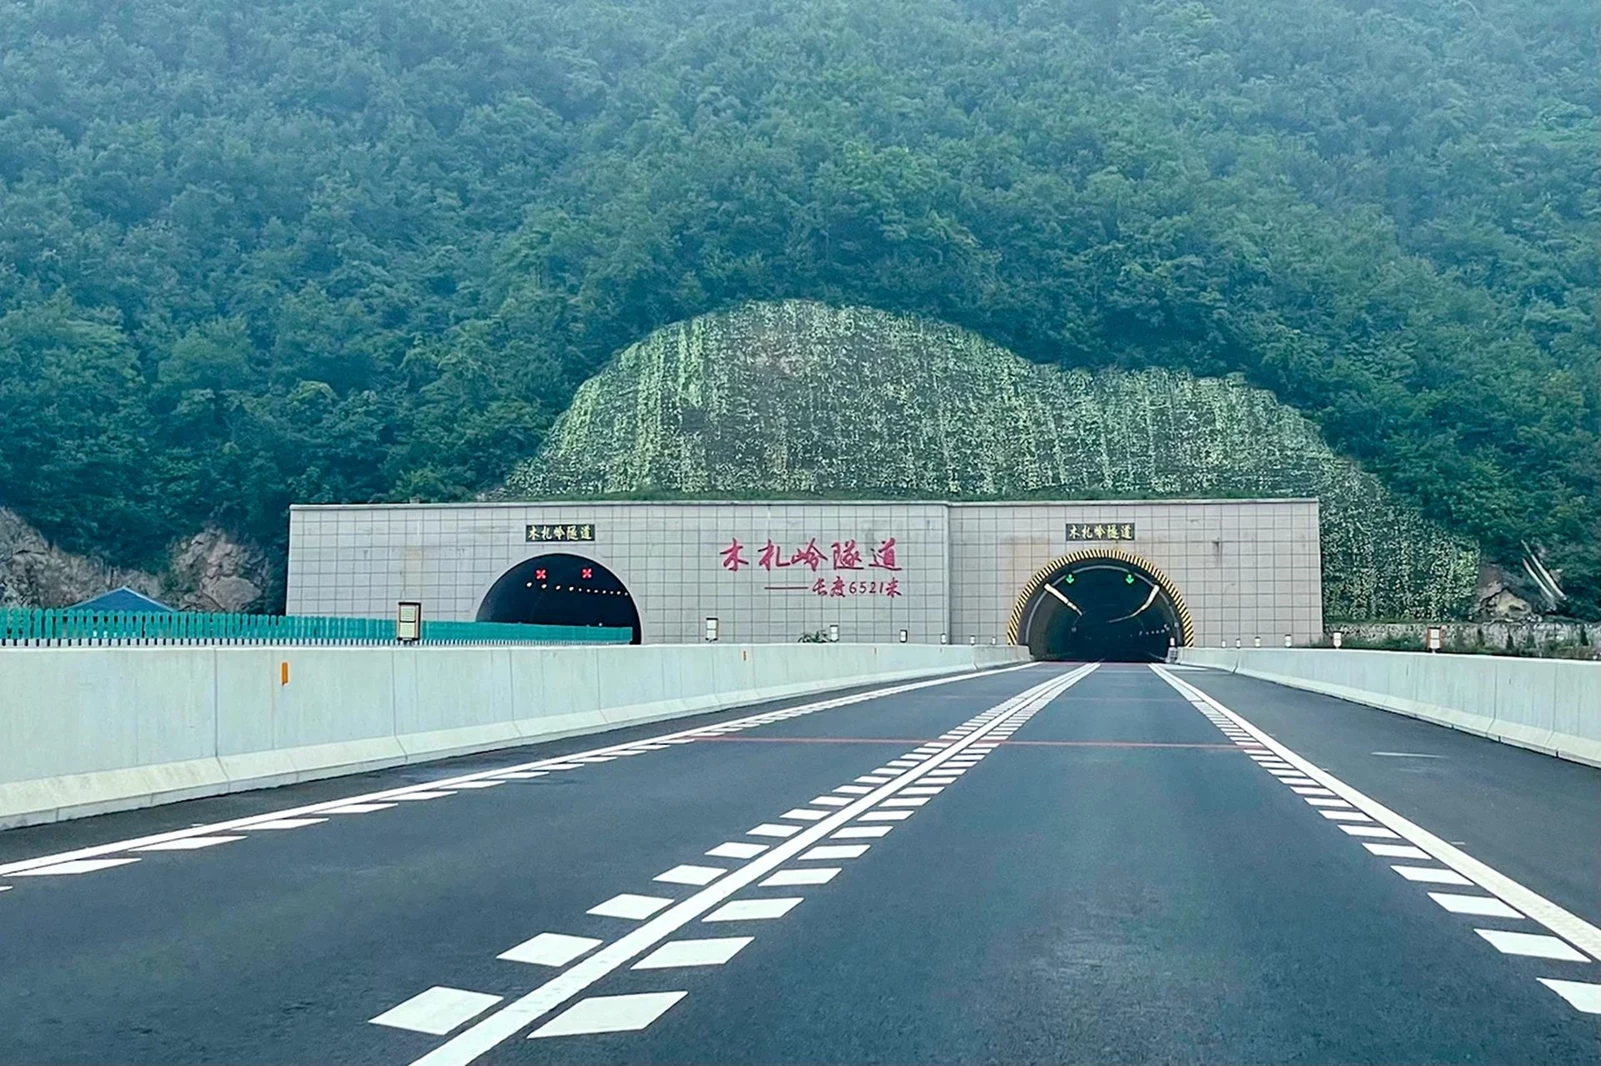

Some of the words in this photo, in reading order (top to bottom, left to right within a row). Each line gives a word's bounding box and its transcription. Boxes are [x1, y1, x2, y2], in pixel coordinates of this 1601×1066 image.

[719, 537, 903, 572] 木札岭隧道
